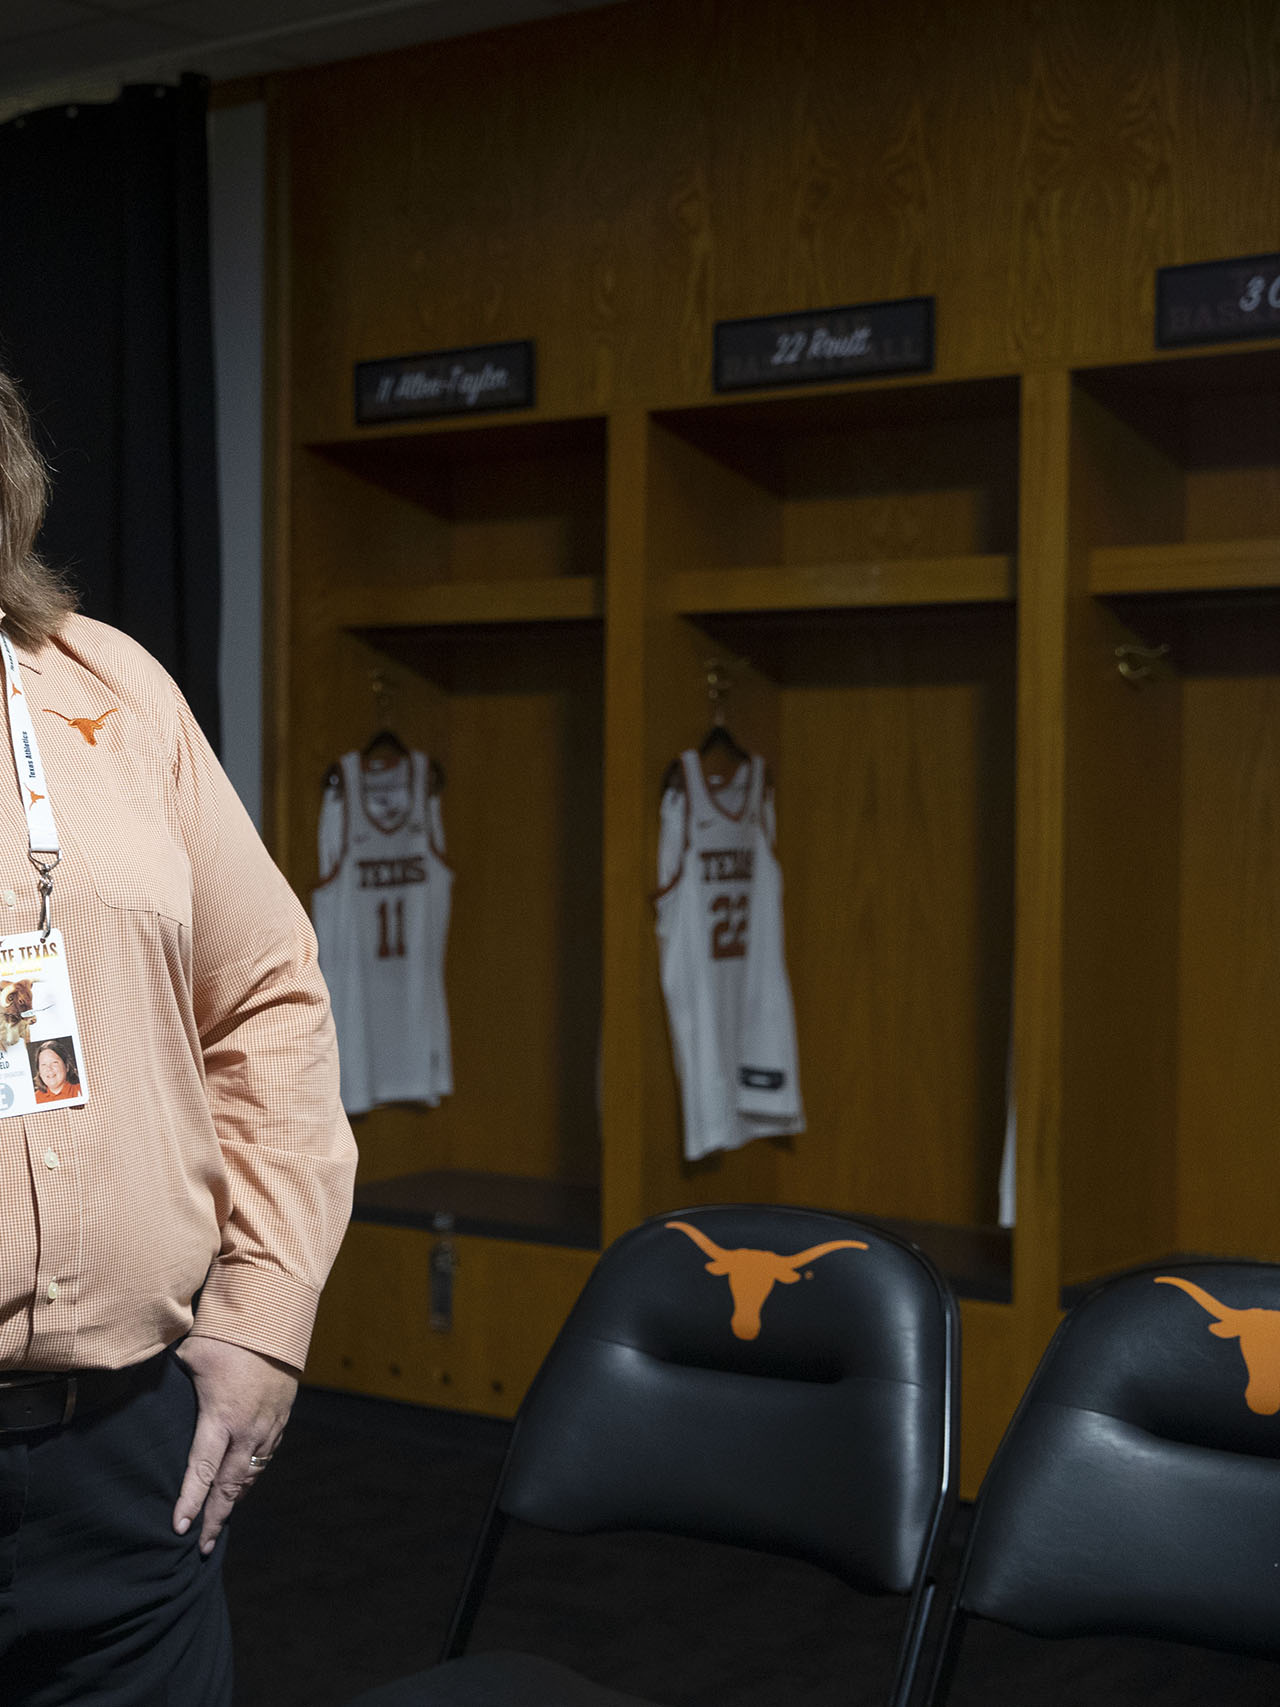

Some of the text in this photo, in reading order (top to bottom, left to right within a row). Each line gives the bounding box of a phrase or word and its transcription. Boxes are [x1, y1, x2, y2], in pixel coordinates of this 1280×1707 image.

[1239, 275, 1265, 312] 3
[770, 331, 807, 365] 22
[22, 731, 33, 760] Athletics
[377, 899, 407, 960] 11
[18, 942, 59, 960] TEXAS
